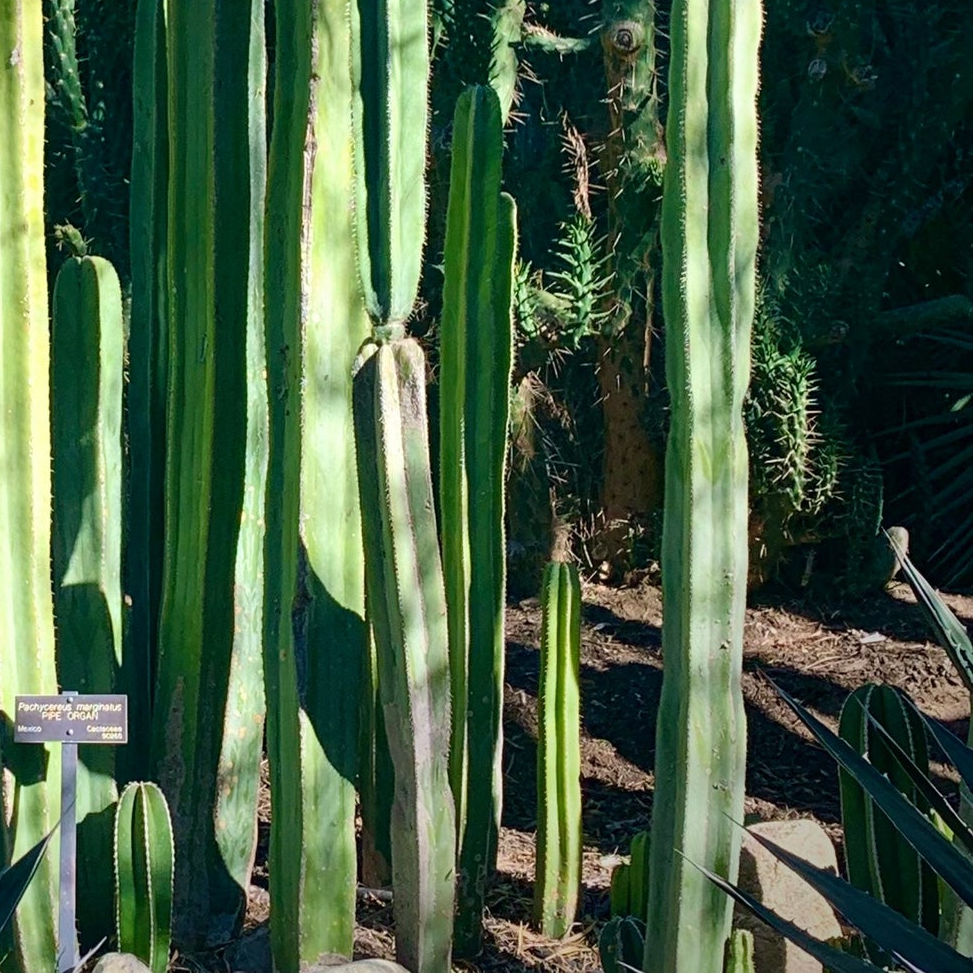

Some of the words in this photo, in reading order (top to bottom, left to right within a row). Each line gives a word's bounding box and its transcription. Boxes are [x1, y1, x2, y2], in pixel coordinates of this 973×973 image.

[18, 702, 72, 713] Pachycereus
[76, 703, 122, 713] marginatus
[42, 711, 62, 721] PIPE
[67, 711, 99, 721] ORGAN
